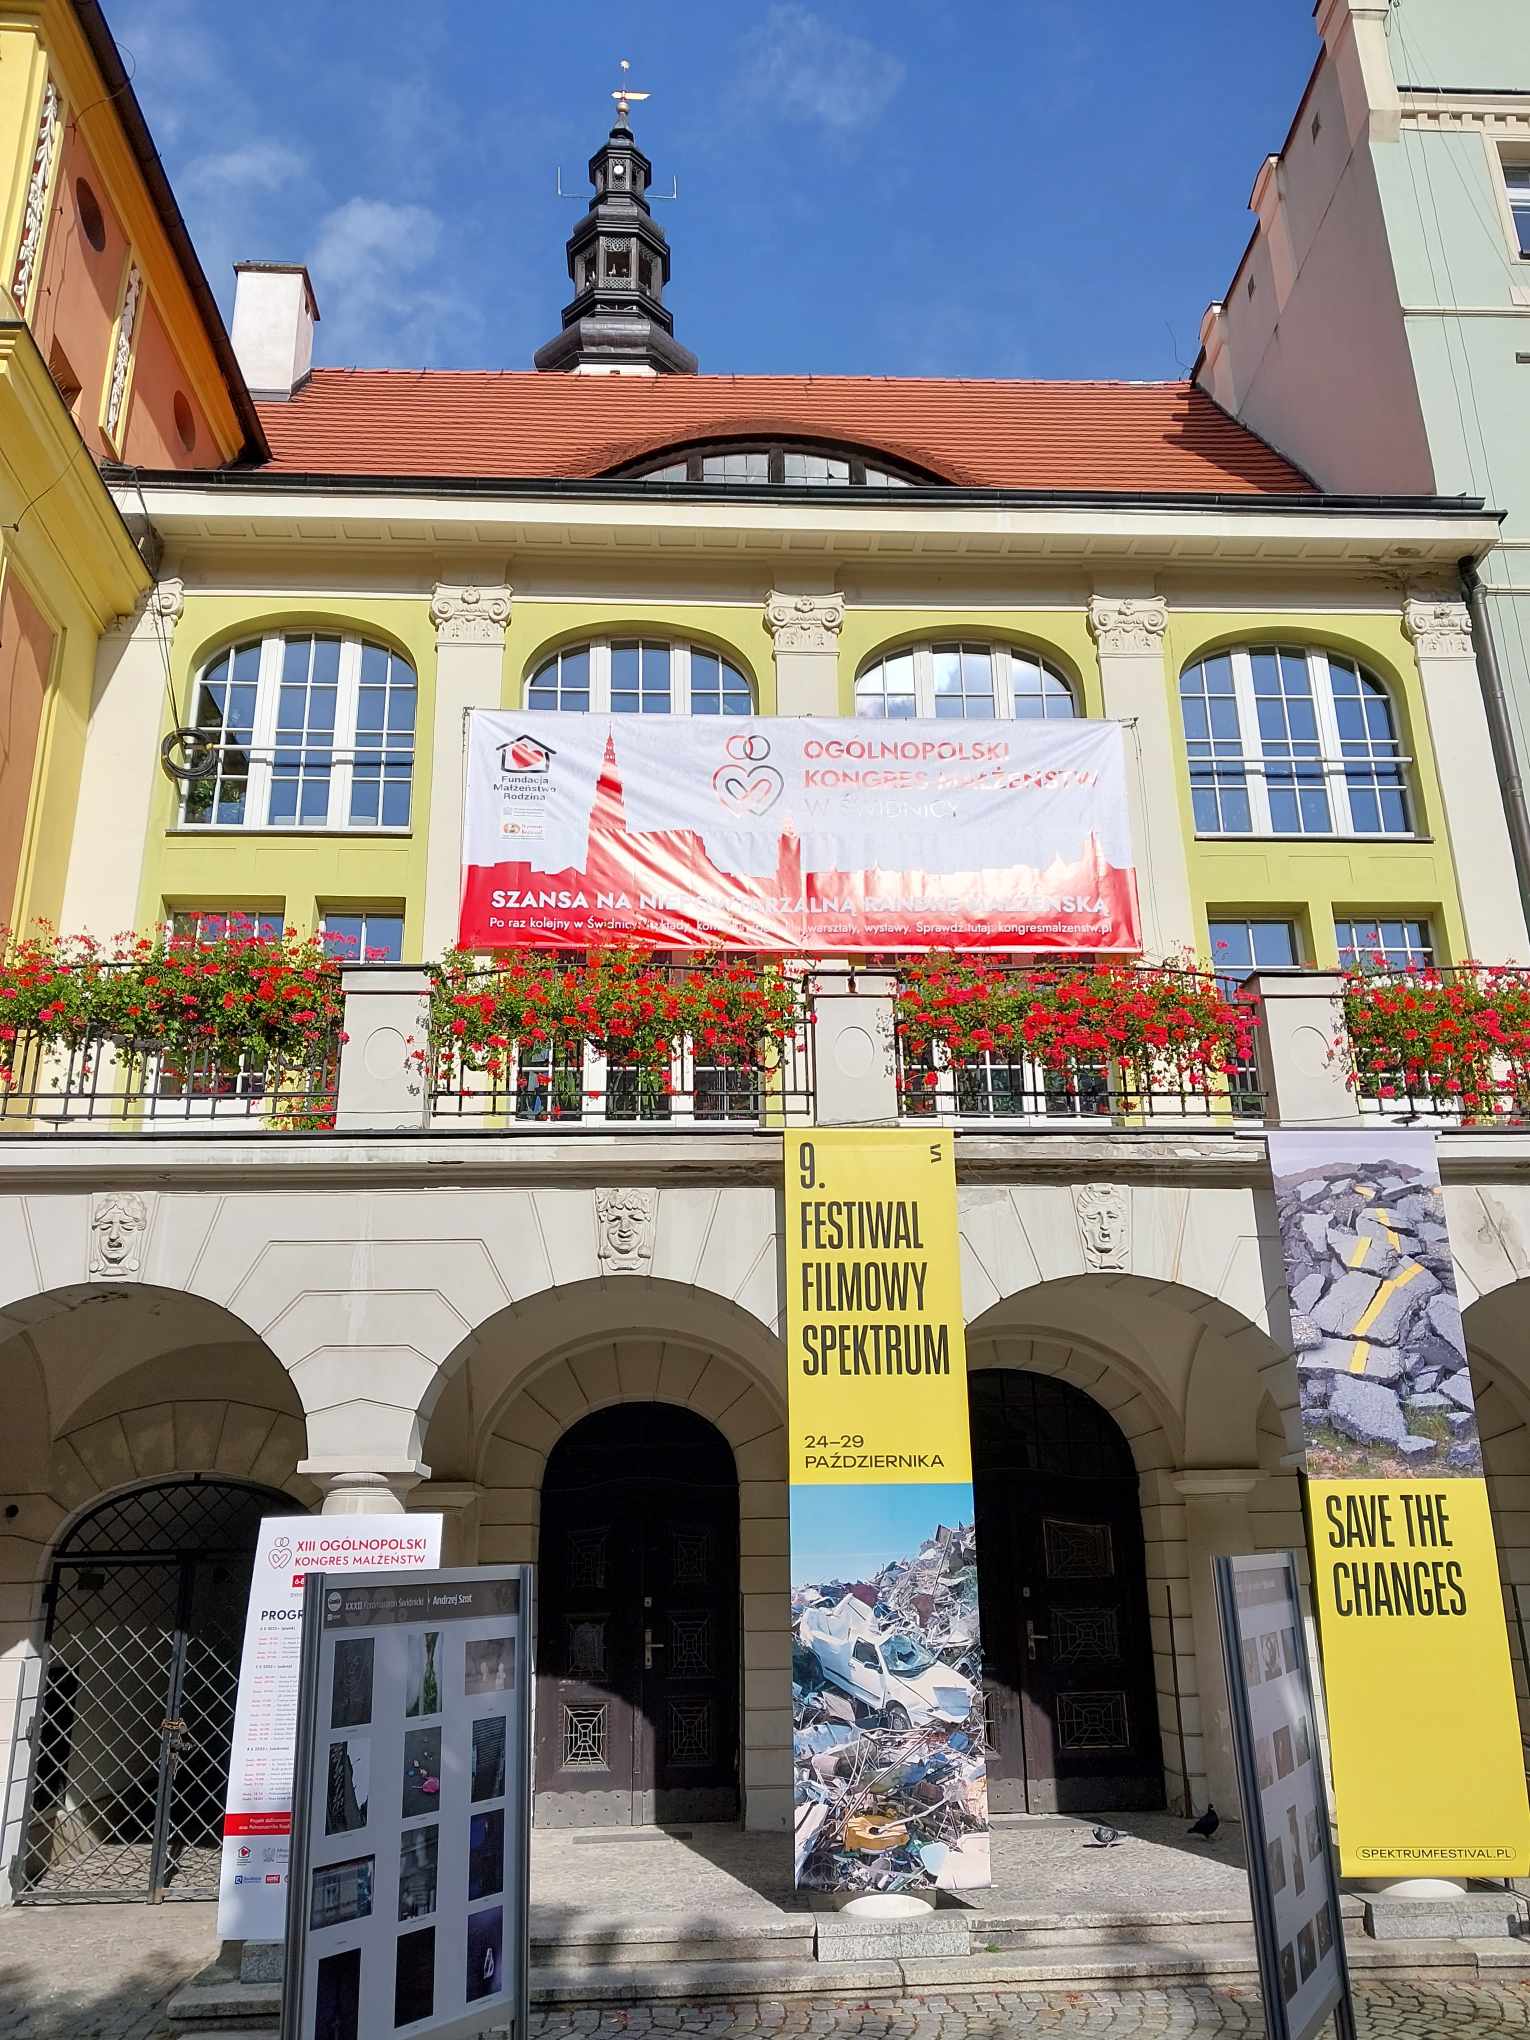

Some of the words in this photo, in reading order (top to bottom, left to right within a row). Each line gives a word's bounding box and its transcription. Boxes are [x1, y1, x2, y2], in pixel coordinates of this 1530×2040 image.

[804, 735, 1009, 761] OGÓLNOPOLSKI
[501, 775, 549, 785] Fundacja
[804, 769, 929, 790] KONGRES
[503, 792, 546, 801] Rodzina
[491, 890, 589, 909] SZANSA
[597, 891, 633, 910] NA
[639, 895, 857, 916] NIEPTARZALNĄ
[489, 917, 504, 928] Po
[508, 920, 526, 928] raz
[530, 917, 570, 931] kolejny
[574, 920, 583, 928] w
[998, 921, 1112, 936] kongresmalzenstw.pl
[799, 1142, 826, 1189] 9.
[801, 1200, 924, 1249] FESTIWAL
[802, 1262, 928, 1312] FILMOWY
[802, 1324, 950, 1377] SPEKTRUM
[805, 1450, 944, 1469] PAŹDZIERNIKA
[1325, 1494, 1396, 1549] SAVE
[1399, 1494, 1454, 1547] THE
[296, 1540, 316, 1553] XIII
[320, 1535, 427, 1552] OGÓLNOPOLSKI
[294, 1555, 349, 1567] KONGRES
[1332, 1561, 1467, 1617] CHANGES
[1361, 1848, 1512, 1860] SPEKTRUMFESTIVAL.PL
